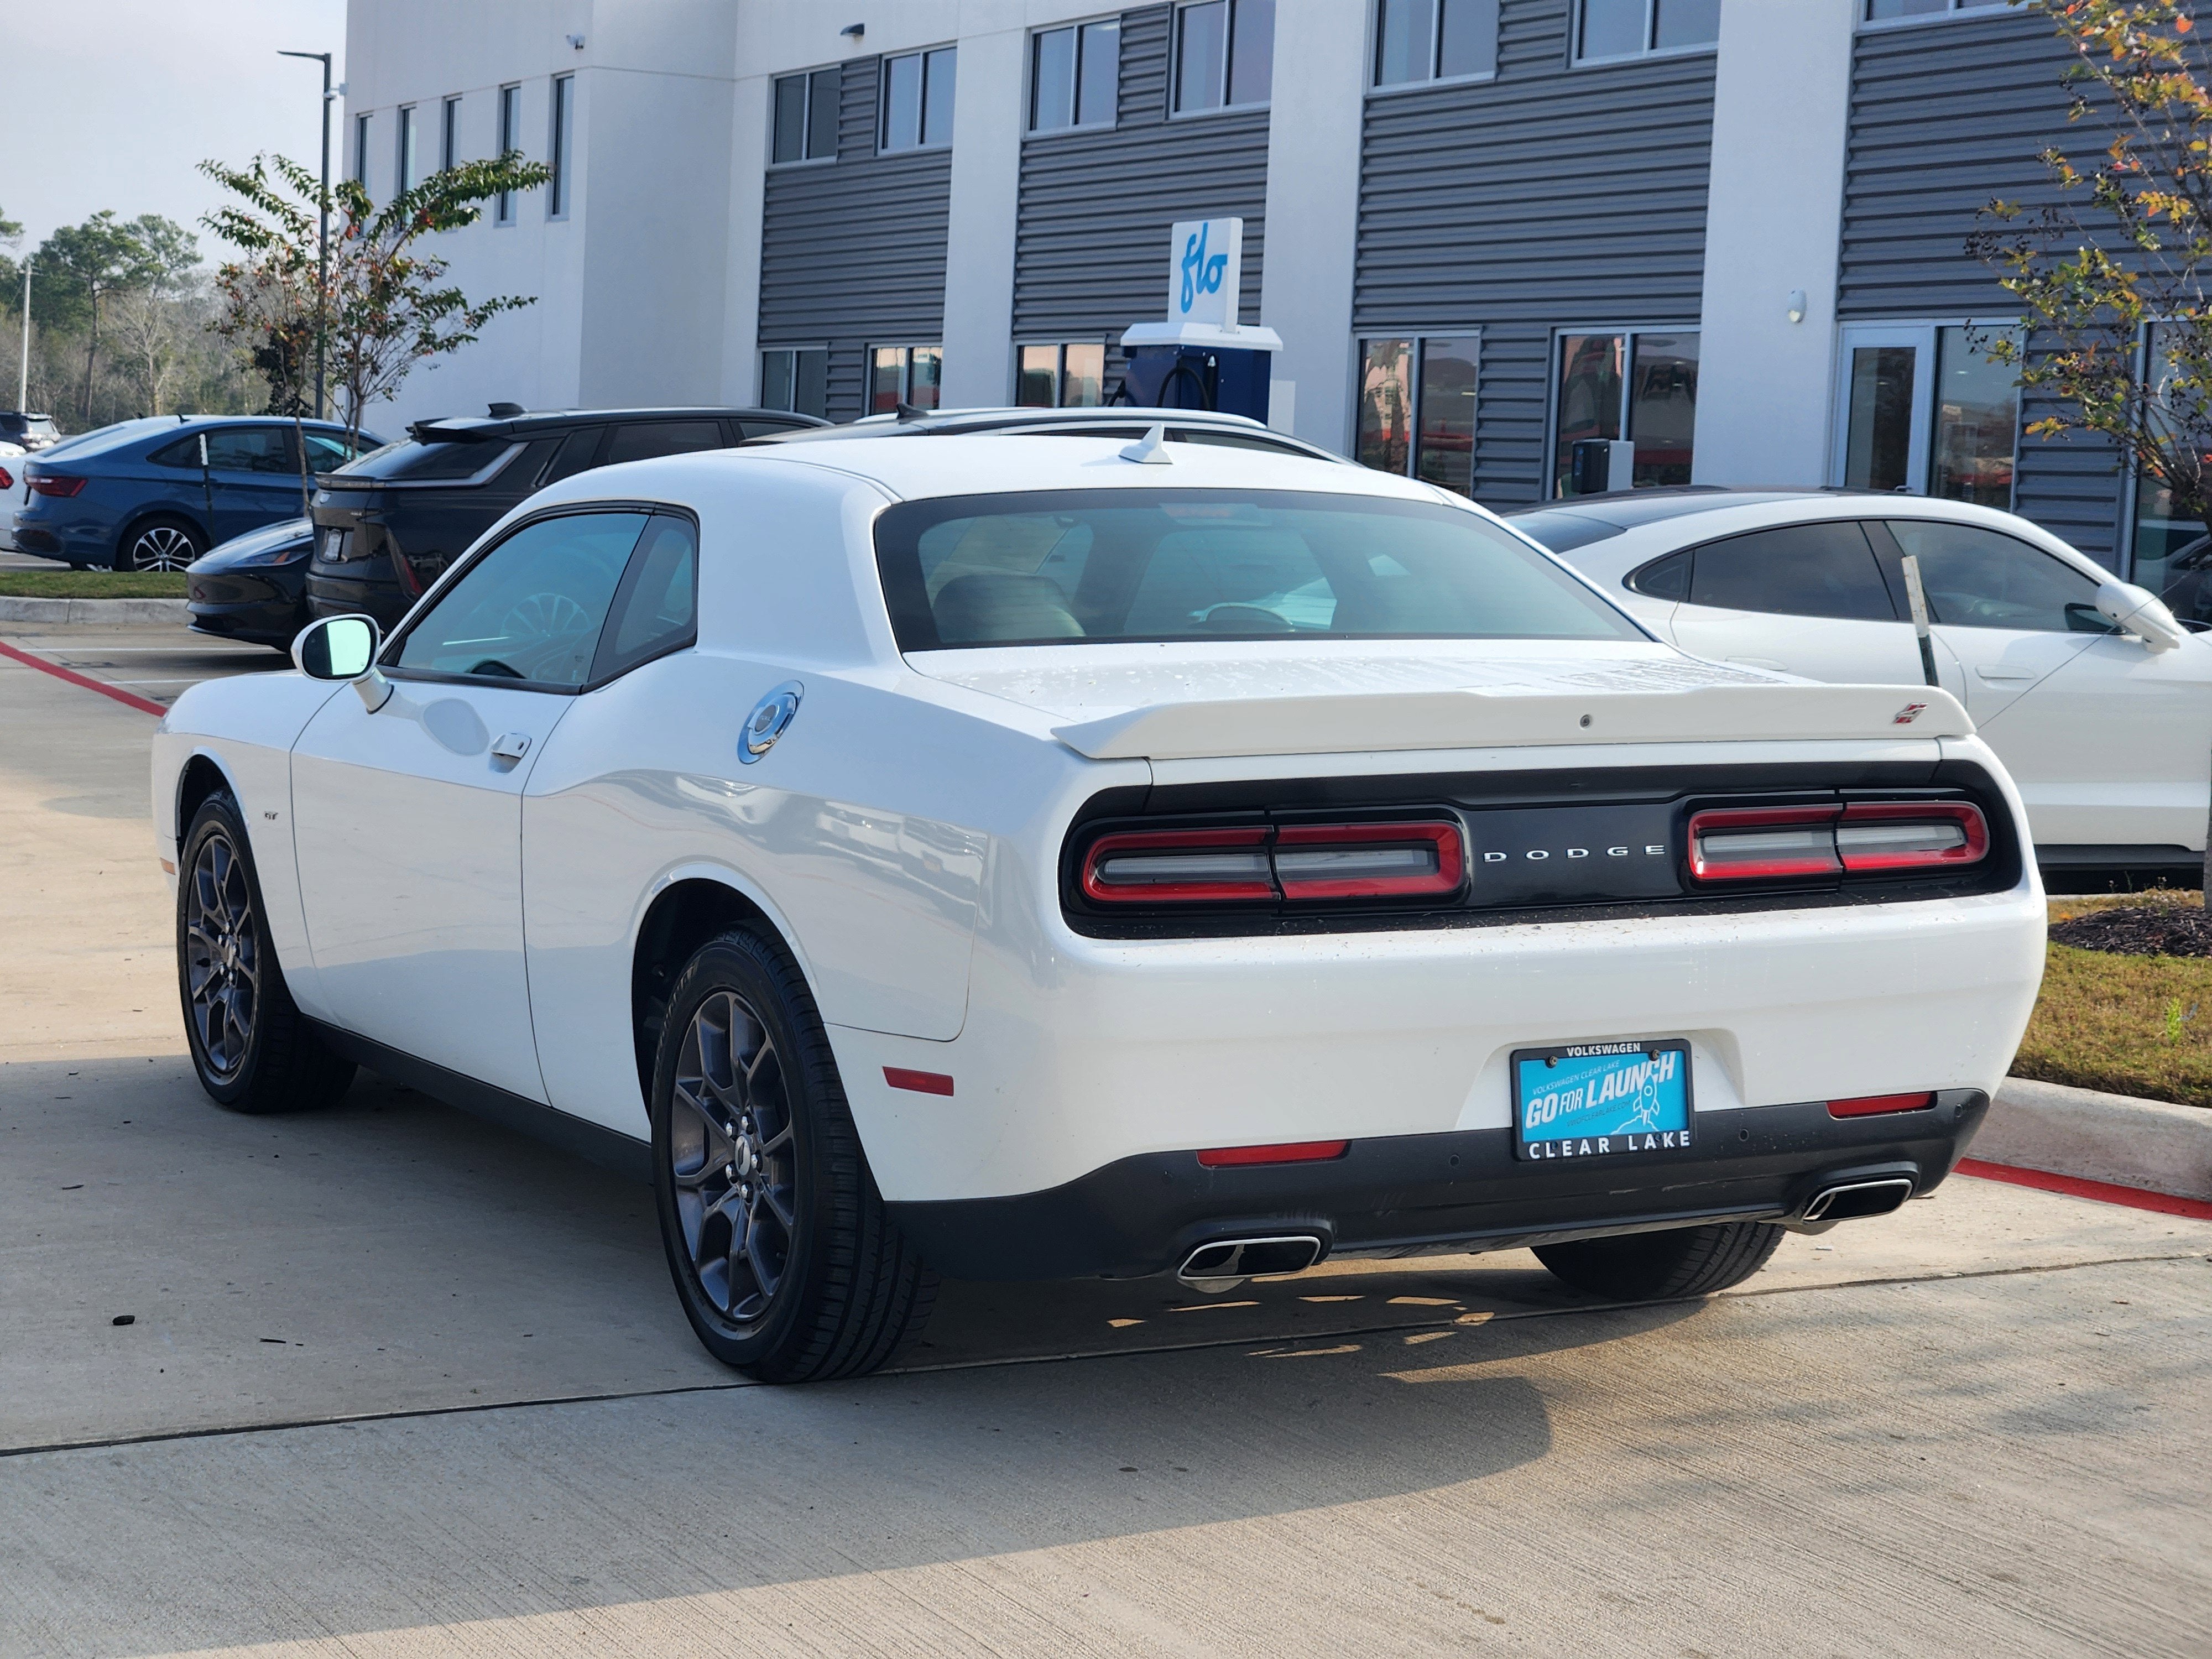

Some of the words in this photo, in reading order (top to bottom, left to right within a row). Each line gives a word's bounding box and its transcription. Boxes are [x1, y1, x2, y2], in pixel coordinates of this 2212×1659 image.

[1181, 222, 1228, 313] flo
[1484, 845, 1665, 862] DODGE
[1567, 1043, 1641, 1057] VOLKSWAGEN
[1525, 1093, 1558, 1129] GO
[1559, 1087, 1584, 1115] FOR
[1585, 1052, 1676, 1109] LAUNCH
[1532, 1074, 1579, 1095] VOLKSWAGEN
[1580, 1066, 1601, 1079] CLEAR
[1603, 1060, 1620, 1072] LAKE
[1528, 1137, 1610, 1160] CLEAR
[1628, 1130, 1691, 1151] LAKE
